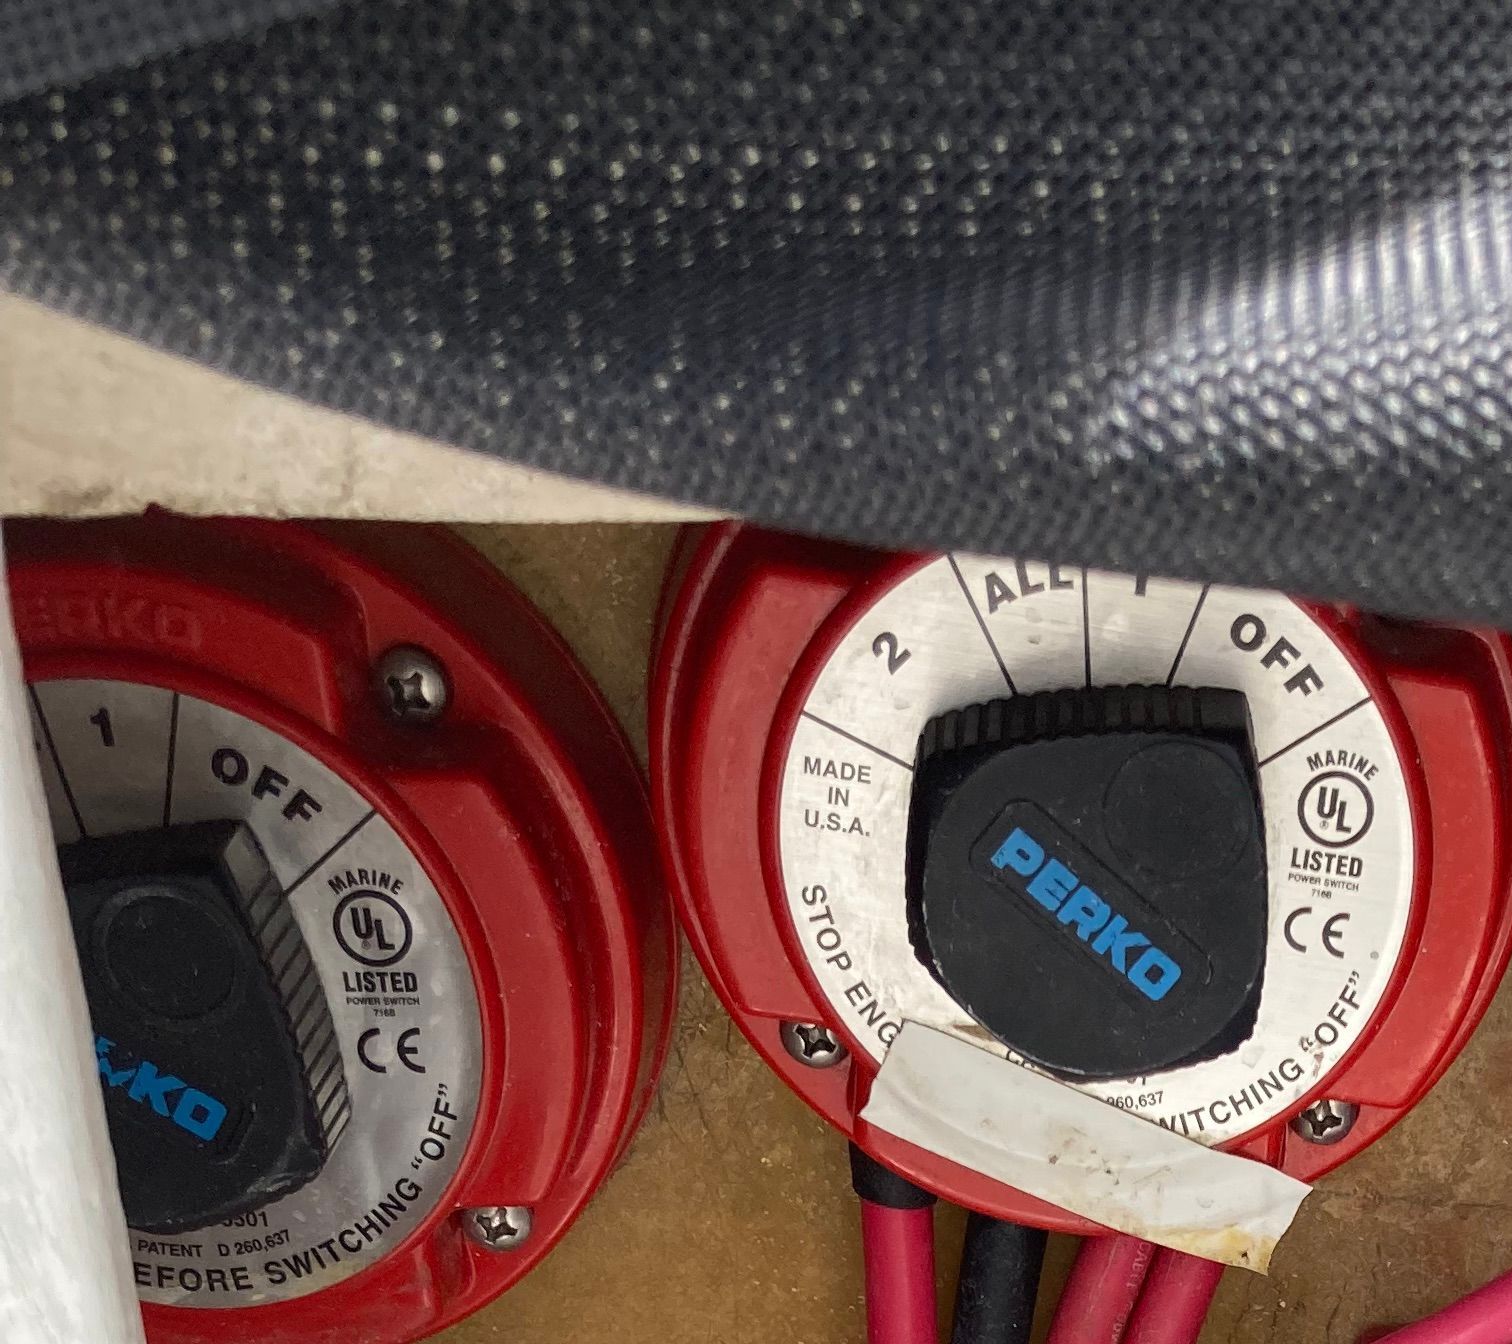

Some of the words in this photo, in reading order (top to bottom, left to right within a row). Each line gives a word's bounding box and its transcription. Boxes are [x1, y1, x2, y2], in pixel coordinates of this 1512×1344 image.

[984, 557, 1074, 613] ALL
[872, 631, 911, 675] 2
[1231, 613, 1324, 696] OFF
[90, 707, 115, 747] 1
[211, 748, 323, 822] OFF
[803, 756, 872, 784] MADE
[1306, 750, 1380, 782] MARINE
[828, 787, 850, 807] IN
[1317, 786, 1352, 834] UL
[804, 810, 871, 837] U.S.A.
[328, 868, 404, 896] MARINE
[1288, 873, 1321, 886] POWER
[1324, 880, 1359, 892] SWITCH
[1291, 847, 1364, 879] LISTED
[350, 907, 396, 950] UL
[801, 885, 852, 973] STOP
[990, 827, 1181, 1001] PERKO
[1284, 907, 1350, 959] CE
[342, 971, 418, 993] LISTED
[346, 997, 381, 1006] POWER
[383, 997, 420, 1006] SWITCH
[357, 1027, 426, 1074] CE
[1150, 1057, 1305, 1137] WITCHING
[138, 1239, 202, 1258] PATENT
[217, 1243, 231, 1257] D
[234, 1229, 290, 1255] 260,637
[264, 1178, 423, 1285] SWITCHING
